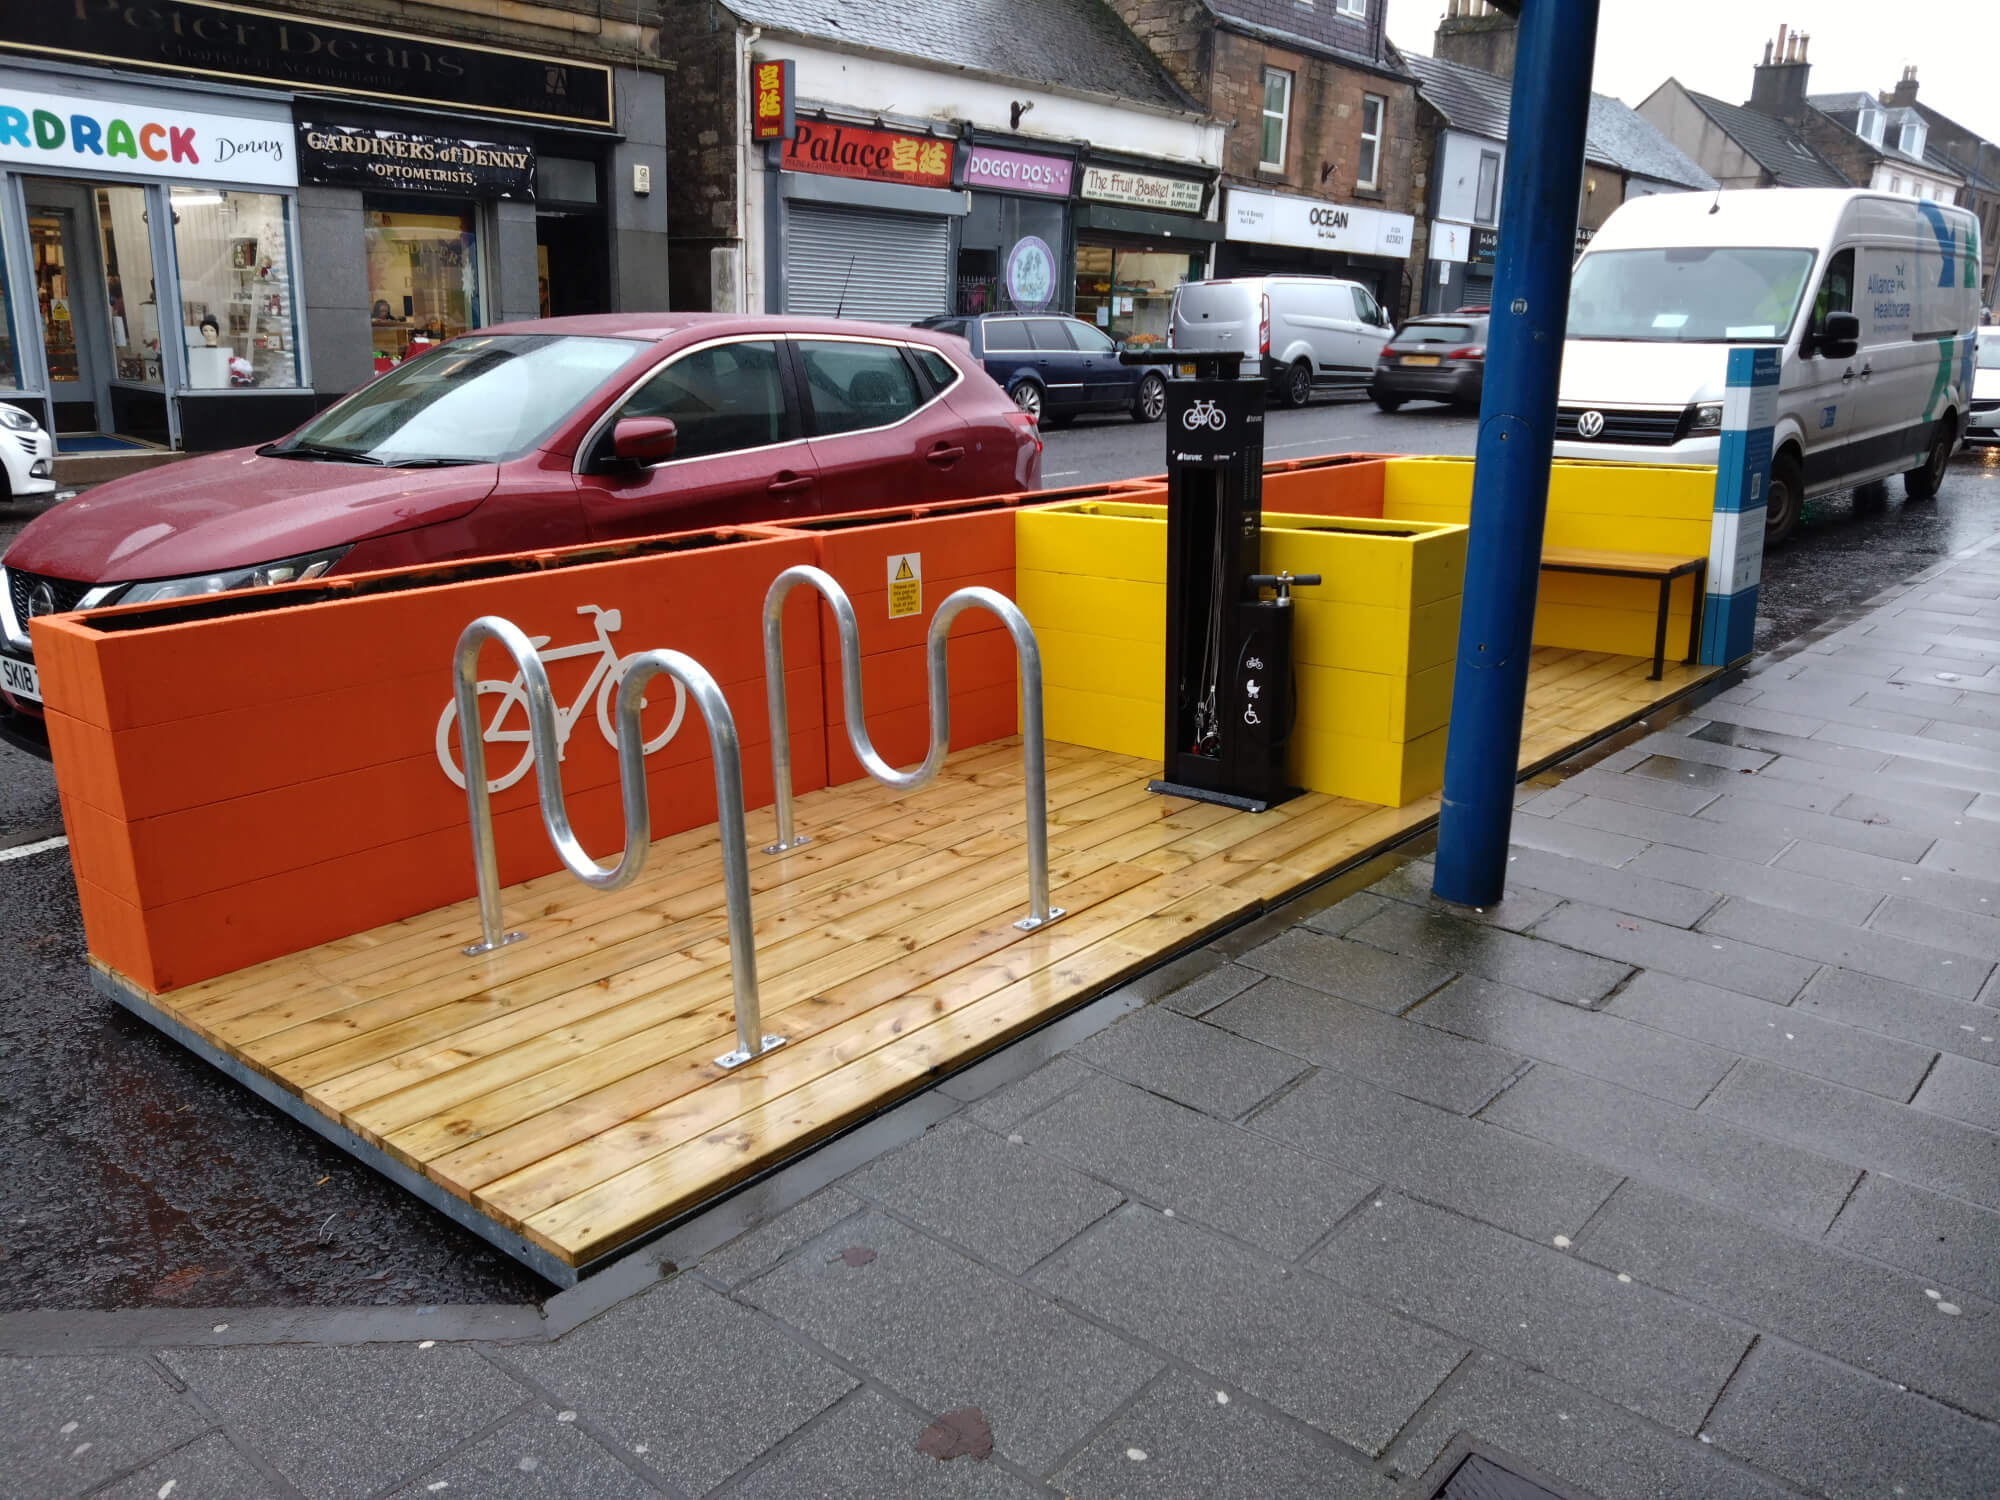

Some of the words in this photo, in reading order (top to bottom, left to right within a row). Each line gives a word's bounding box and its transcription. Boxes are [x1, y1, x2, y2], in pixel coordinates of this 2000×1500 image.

[279, 25, 465, 77] Deans
[0, 105, 199, 165] RDRACK
[214, 137, 284, 163] Denny
[788, 126, 890, 169] Palace
[306, 132, 435, 161] GARDINERS
[440, 147, 459, 163] of
[462, 148, 529, 170] DENNY
[375, 164, 474, 185] OPTOMETRISTS
[970, 156, 1019, 179] DOGGY
[1021, 165, 1051, 184] DO'S
[1089, 170, 1108, 191] The
[1111, 174, 1134, 194] Fruit
[1135, 177, 1169, 199] Basket
[1309, 207, 1349, 229] OCEAN
[1867, 274, 1895, 294] Alliance
[1874, 301, 1910, 319] Healthcare
[3, 660, 34, 693] SK18
